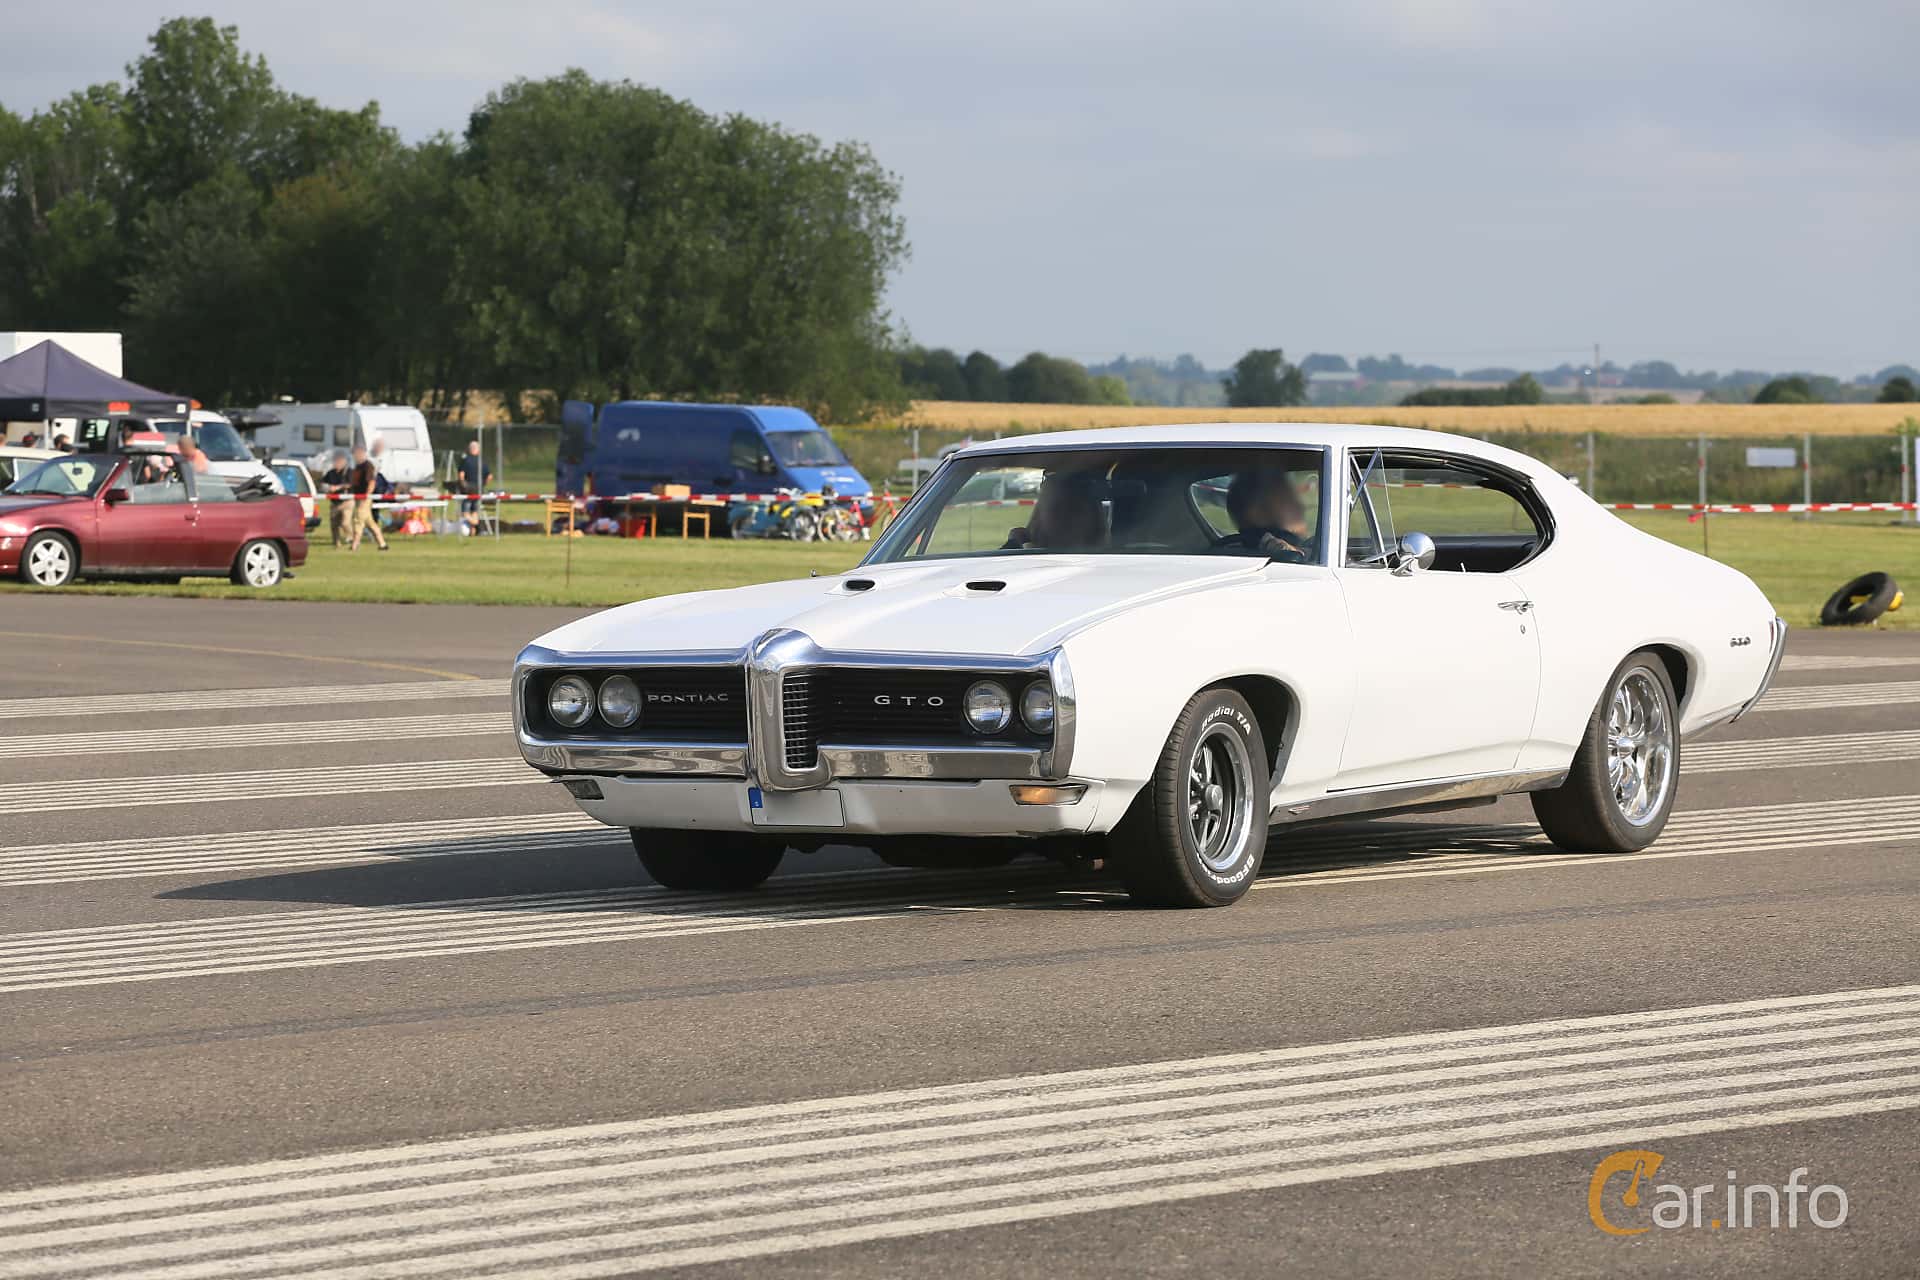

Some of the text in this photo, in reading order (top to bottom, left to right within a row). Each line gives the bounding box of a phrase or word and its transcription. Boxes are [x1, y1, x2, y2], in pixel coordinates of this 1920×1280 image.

[648, 693, 729, 703] PONTIAC
[874, 695, 944, 706] GTO
[1236, 711, 1251, 735] T/A
[1196, 853, 1255, 884] BFGood
